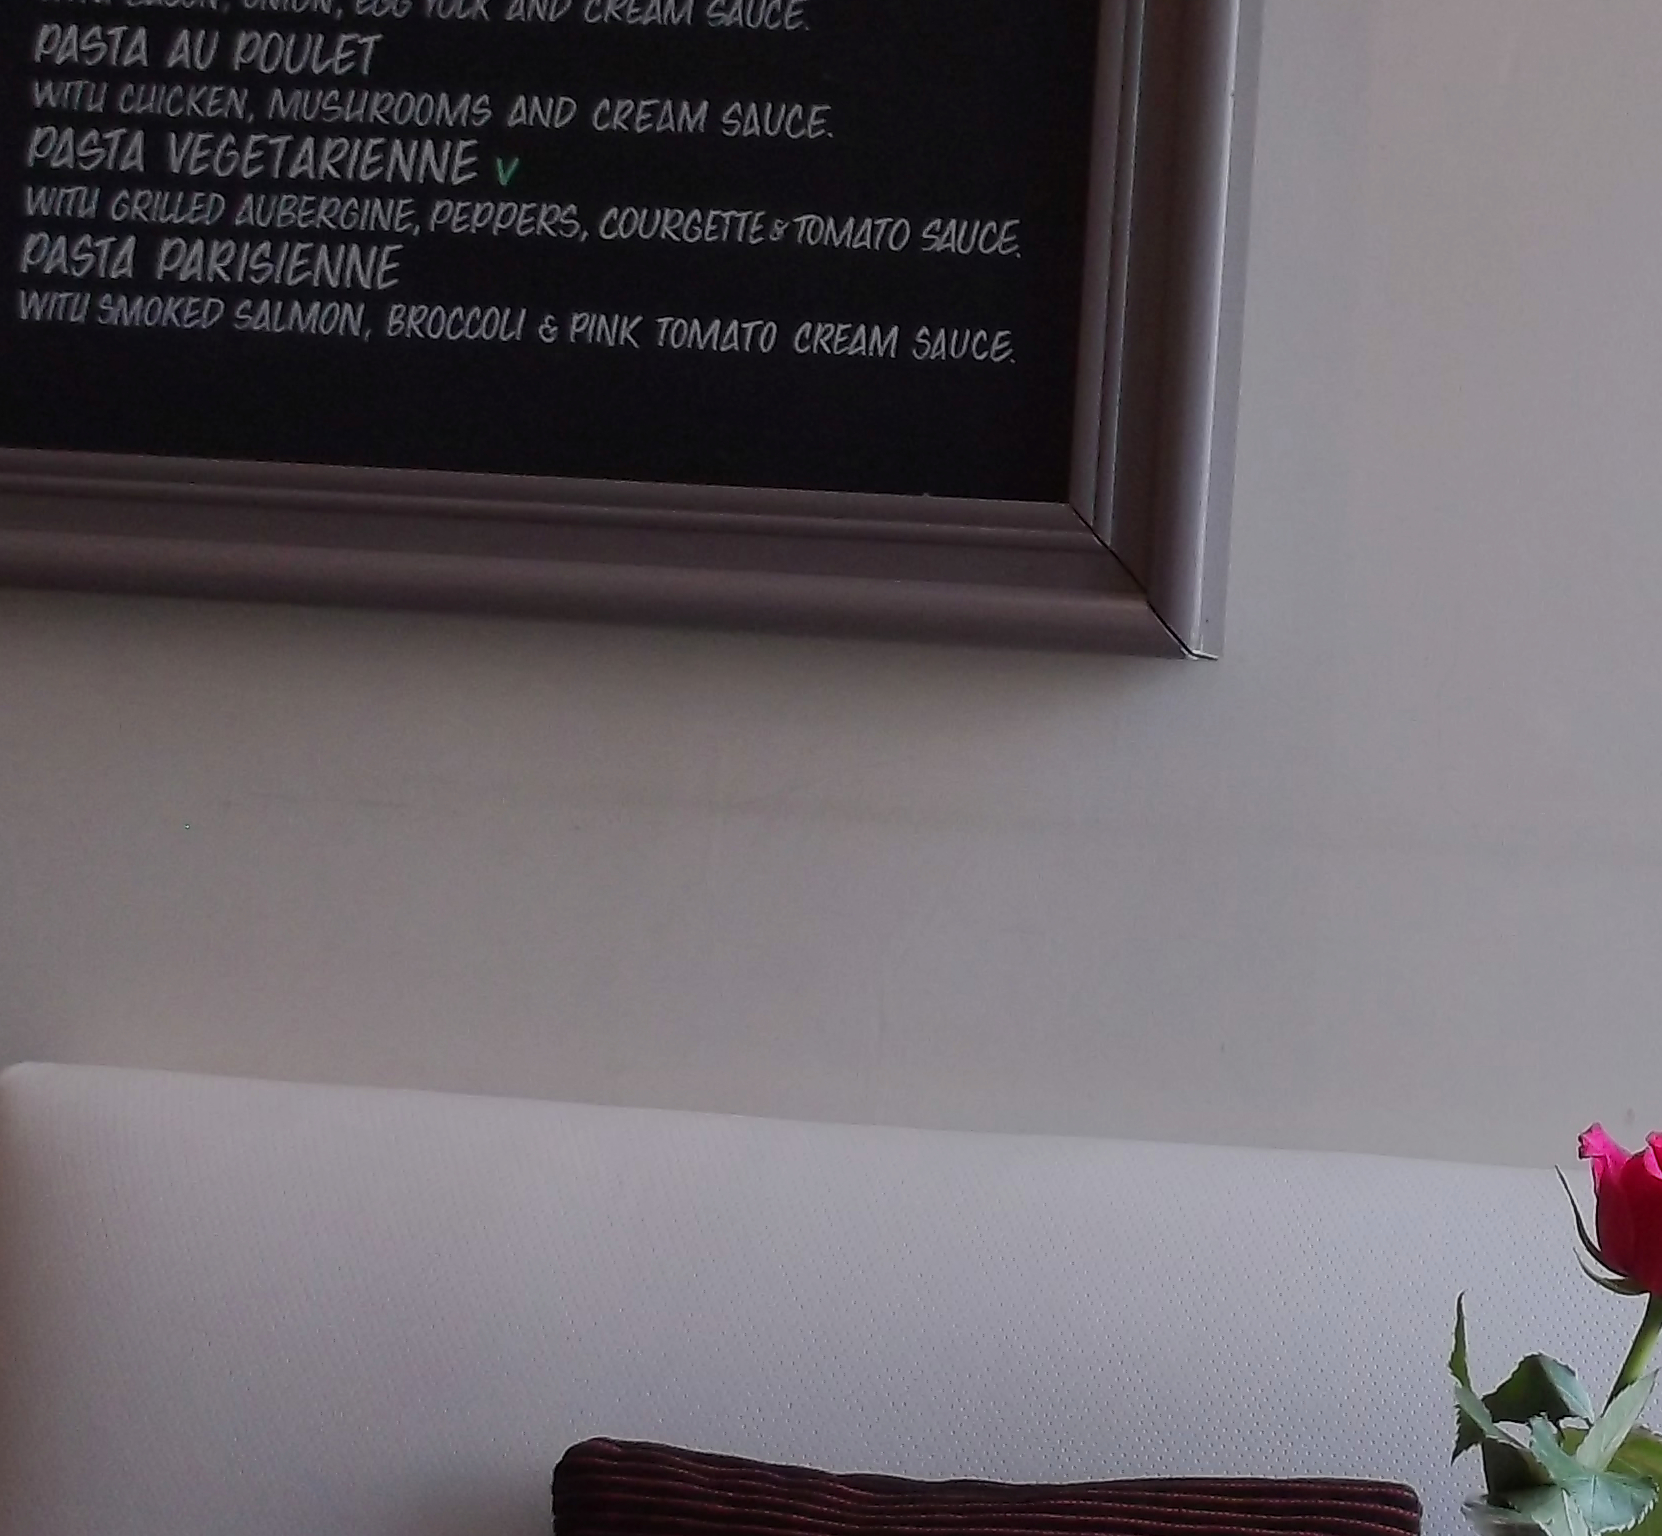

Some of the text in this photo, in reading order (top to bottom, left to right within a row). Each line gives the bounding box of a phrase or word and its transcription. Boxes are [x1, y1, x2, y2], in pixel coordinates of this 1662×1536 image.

[35, 24, 382, 75] PASTA AU POULET
[33, 81, 107, 112] WITH
[269, 89, 491, 126] MUSHROOMS
[508, 96, 576, 128] AND
[593, 99, 708, 133] CREAM
[28, 126, 144, 171] PASTA
[170, 132, 477, 185] VEGETARIENNE
[26, 186, 99, 218] WITH
[111, 190, 225, 225] GRILLED
[600, 207, 765, 244] COURGETTE
[793, 215, 910, 250] TOMATO
[21, 232, 403, 289] PASTA PARISIENNE
[20, 291, 90, 322] WITH
[98, 294, 224, 328] SMOKED
[387, 304, 526, 341] BROCCOLI
[570, 313, 643, 348] PINK
[656, 317, 777, 352] TOMATO
[794, 322, 899, 357] CREAM
